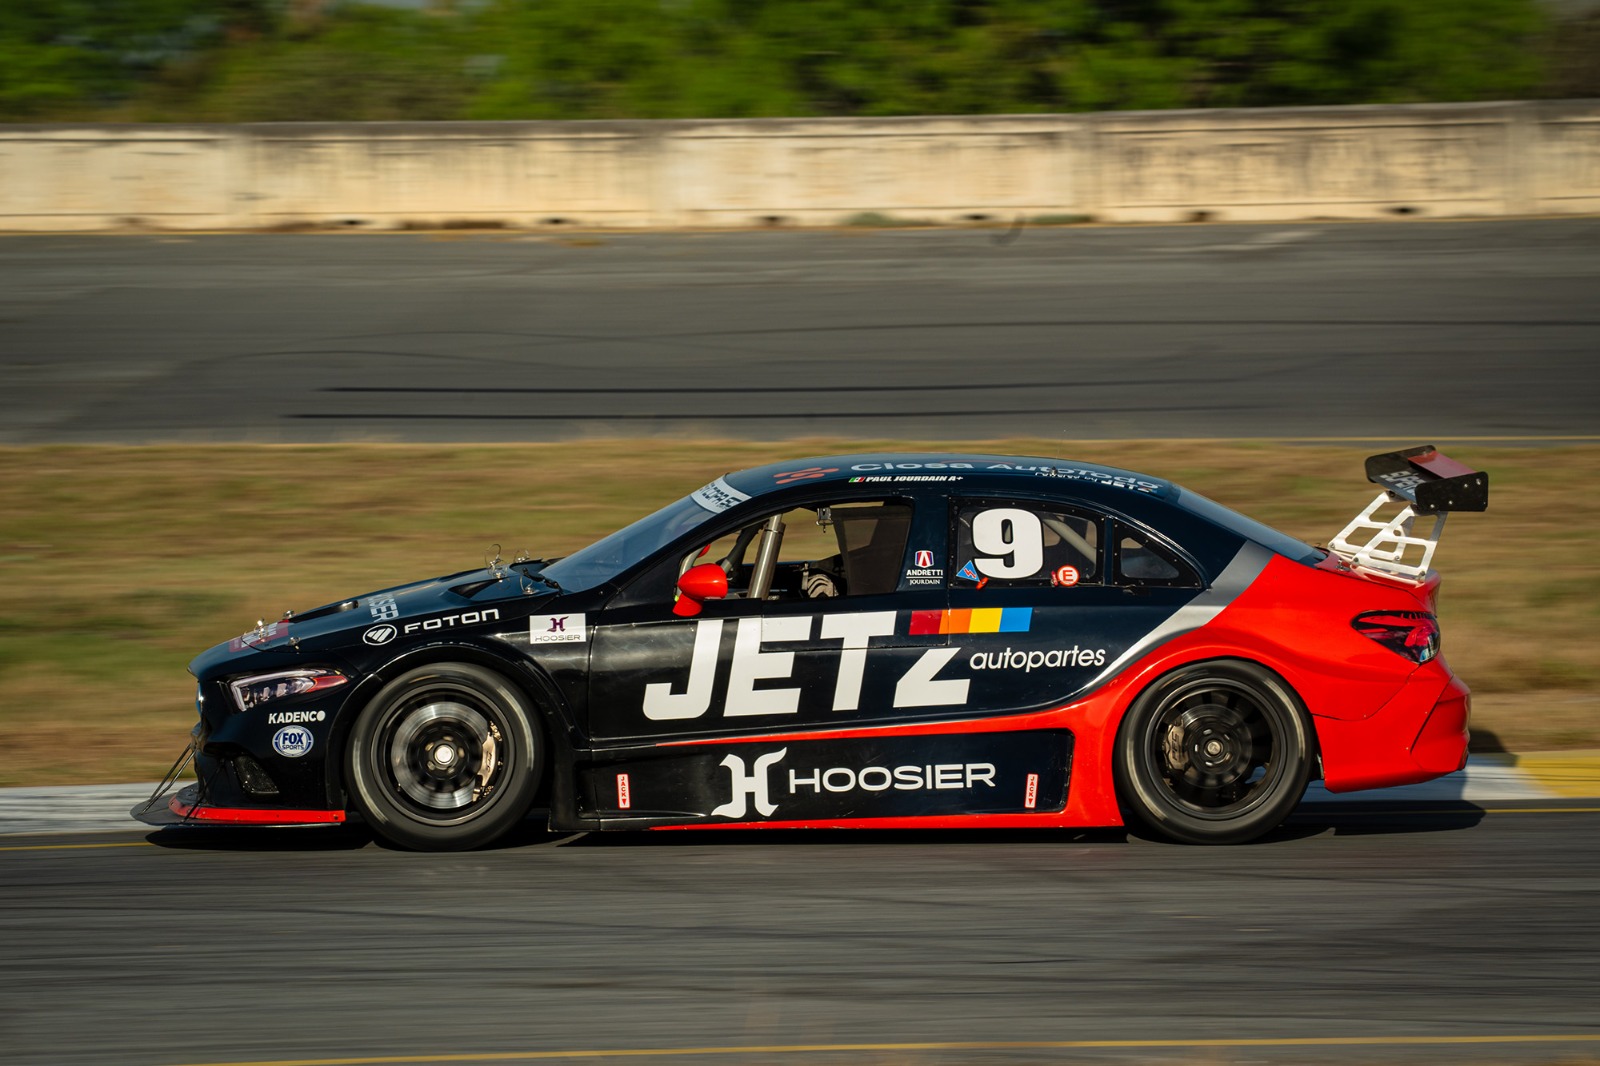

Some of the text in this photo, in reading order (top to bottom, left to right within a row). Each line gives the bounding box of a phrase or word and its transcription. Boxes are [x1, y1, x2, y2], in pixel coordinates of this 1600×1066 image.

[972, 508, 1044, 579] 9
[1062, 569, 1074, 582] E
[404, 608, 500, 634] FOTON
[535, 634, 581, 642] HOOSIER
[643, 610, 971, 720] JETZ
[969, 644, 1107, 673] autopartes
[282, 732, 304, 745] FOX
[789, 762, 997, 794] HOOSIER
